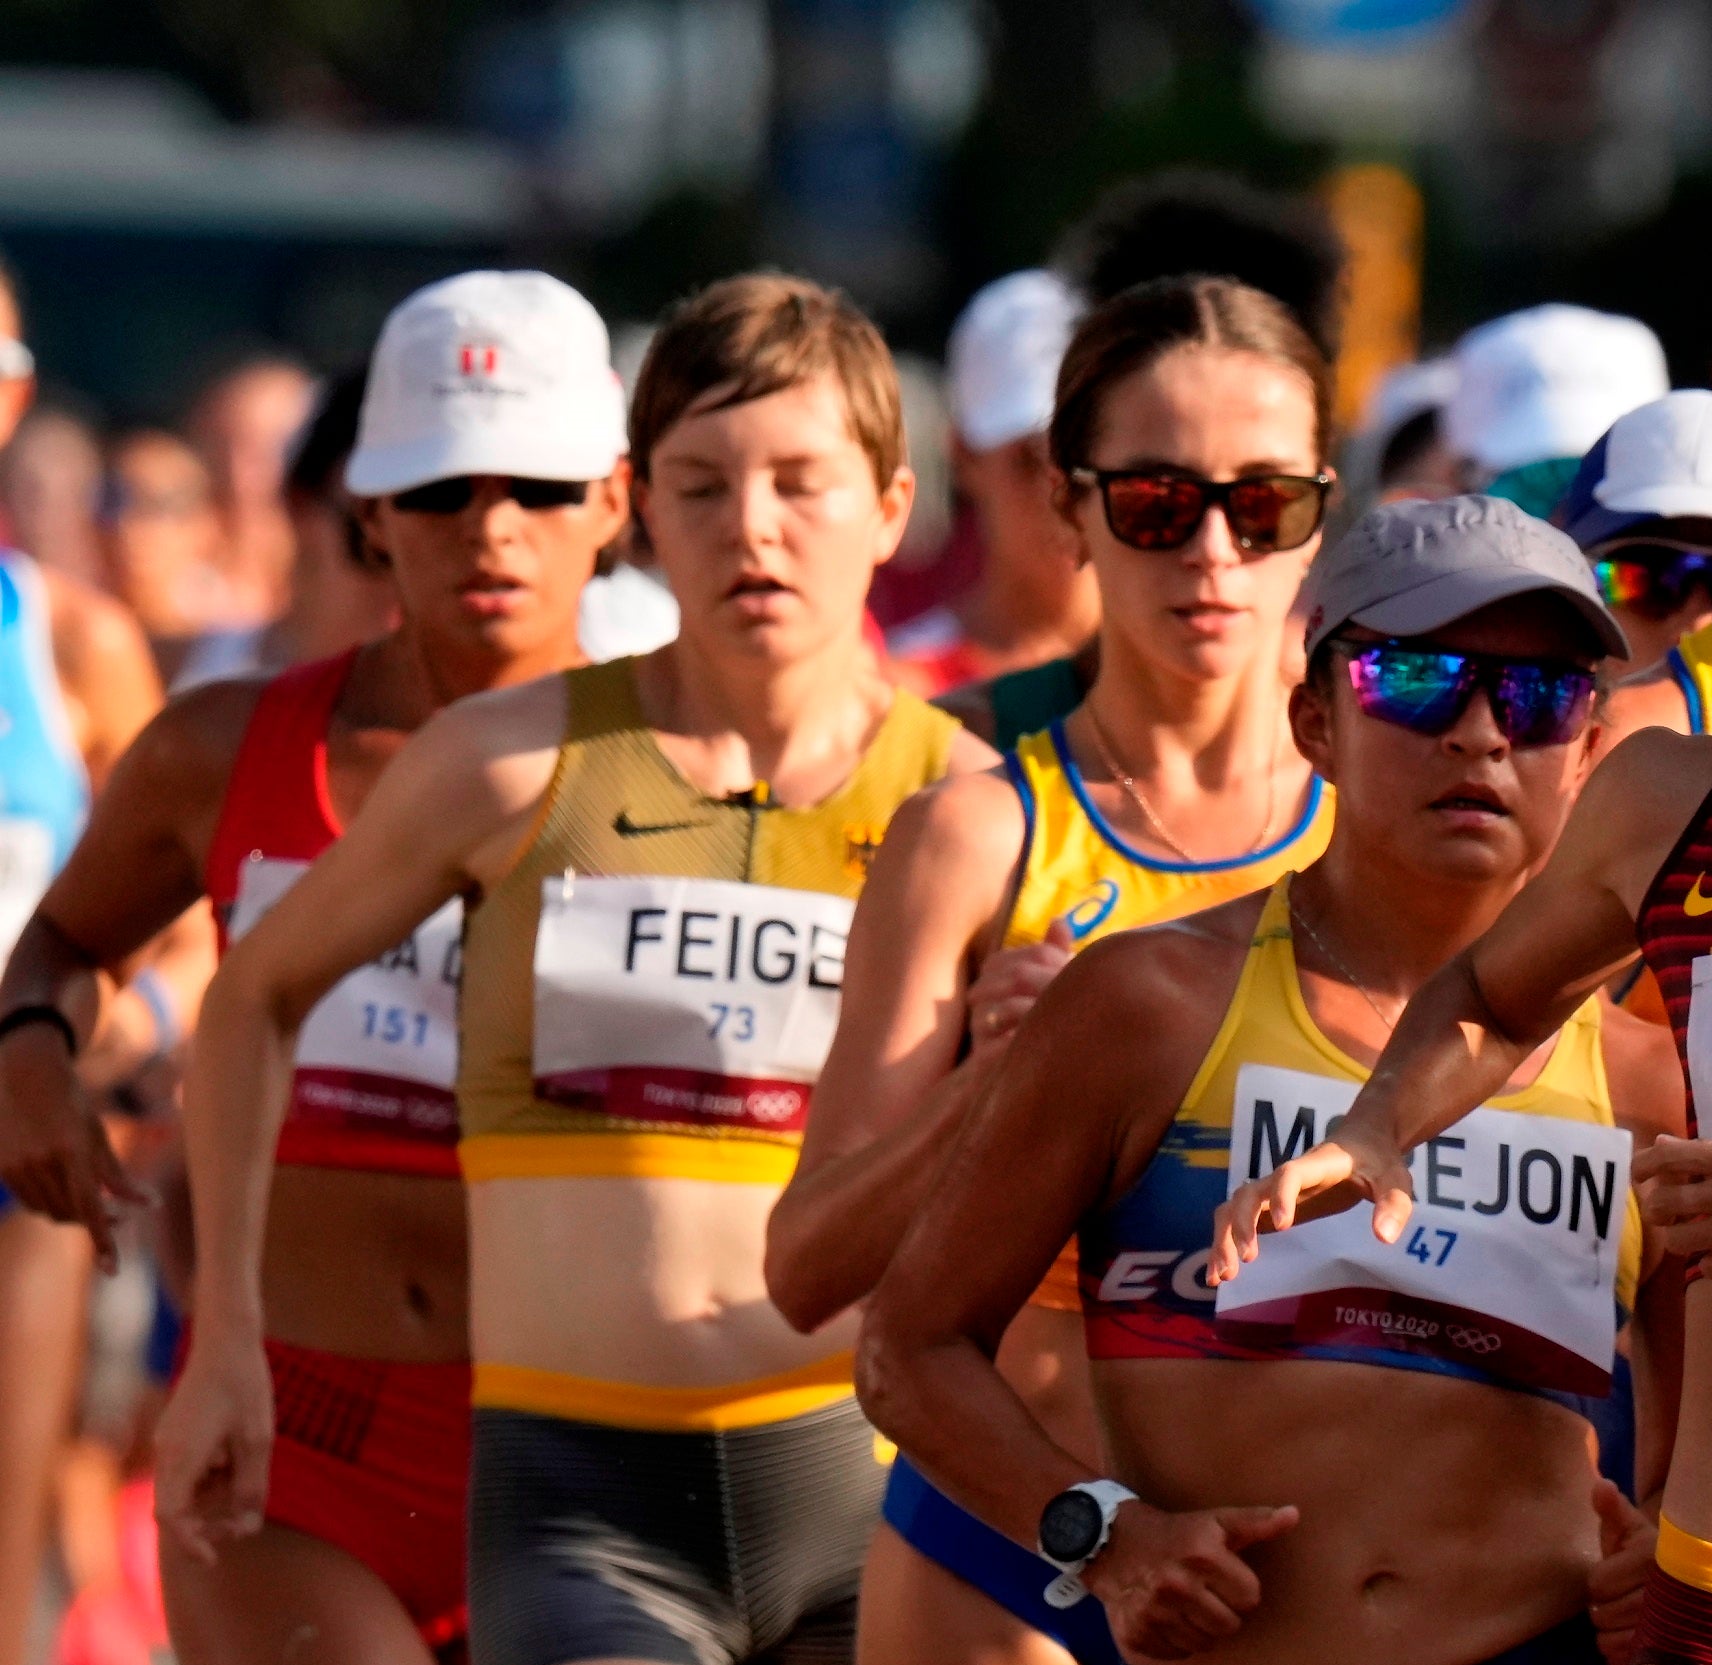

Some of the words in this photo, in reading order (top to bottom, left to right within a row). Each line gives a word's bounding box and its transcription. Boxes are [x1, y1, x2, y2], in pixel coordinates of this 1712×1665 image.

[363, 1003, 429, 1047] 151
[710, 1003, 755, 1042] 73
[1248, 1098, 1616, 1241] MEJON
[1406, 1226, 1458, 1267] 47
[1335, 1306, 1393, 1328] TOKYO
[1395, 1314, 1440, 1336] 2020
